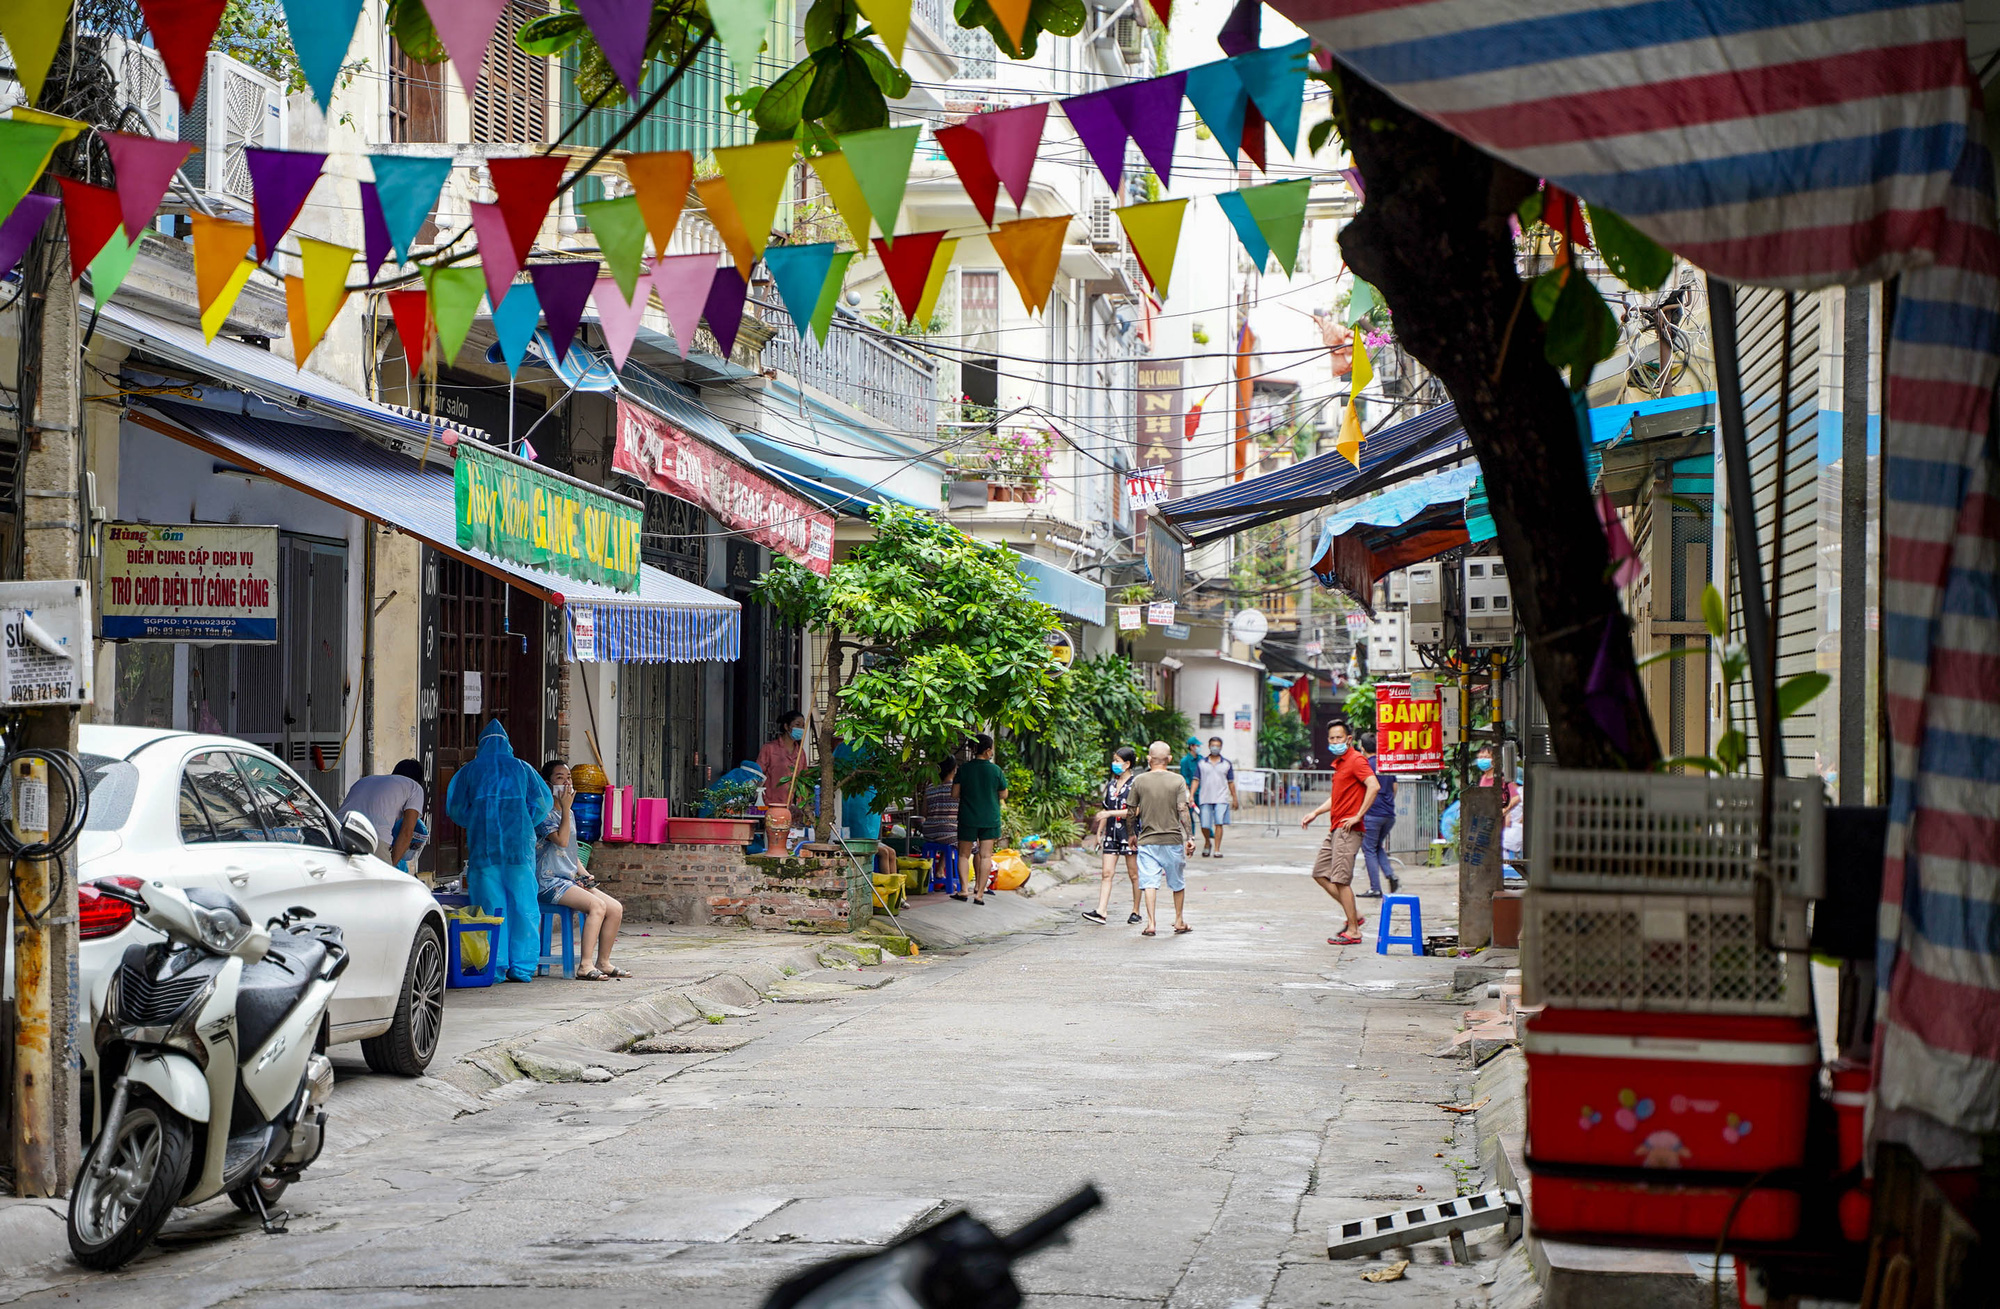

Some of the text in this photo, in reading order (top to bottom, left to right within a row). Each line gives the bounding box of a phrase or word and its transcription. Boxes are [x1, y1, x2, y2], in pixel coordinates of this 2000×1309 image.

[1155, 369, 1181, 386] OANH
[446, 396, 469, 419] salon
[676, 444, 704, 492] BÚN
[1127, 474, 1166, 495] TIVI
[109, 527, 148, 542] Hùng
[127, 544, 253, 569] ĐIỂM CUNG CẤP DỊCH VỤ
[111, 566, 269, 614] TRÒ CHƠI ĐIỆN TỬ CÔNG CỘNG
[11, 681, 72, 702] 0926 721 567
[546, 678, 559, 720] TÓC
[1379, 701, 1440, 724] BÁNH
[1388, 725, 1433, 751] PHỞ
